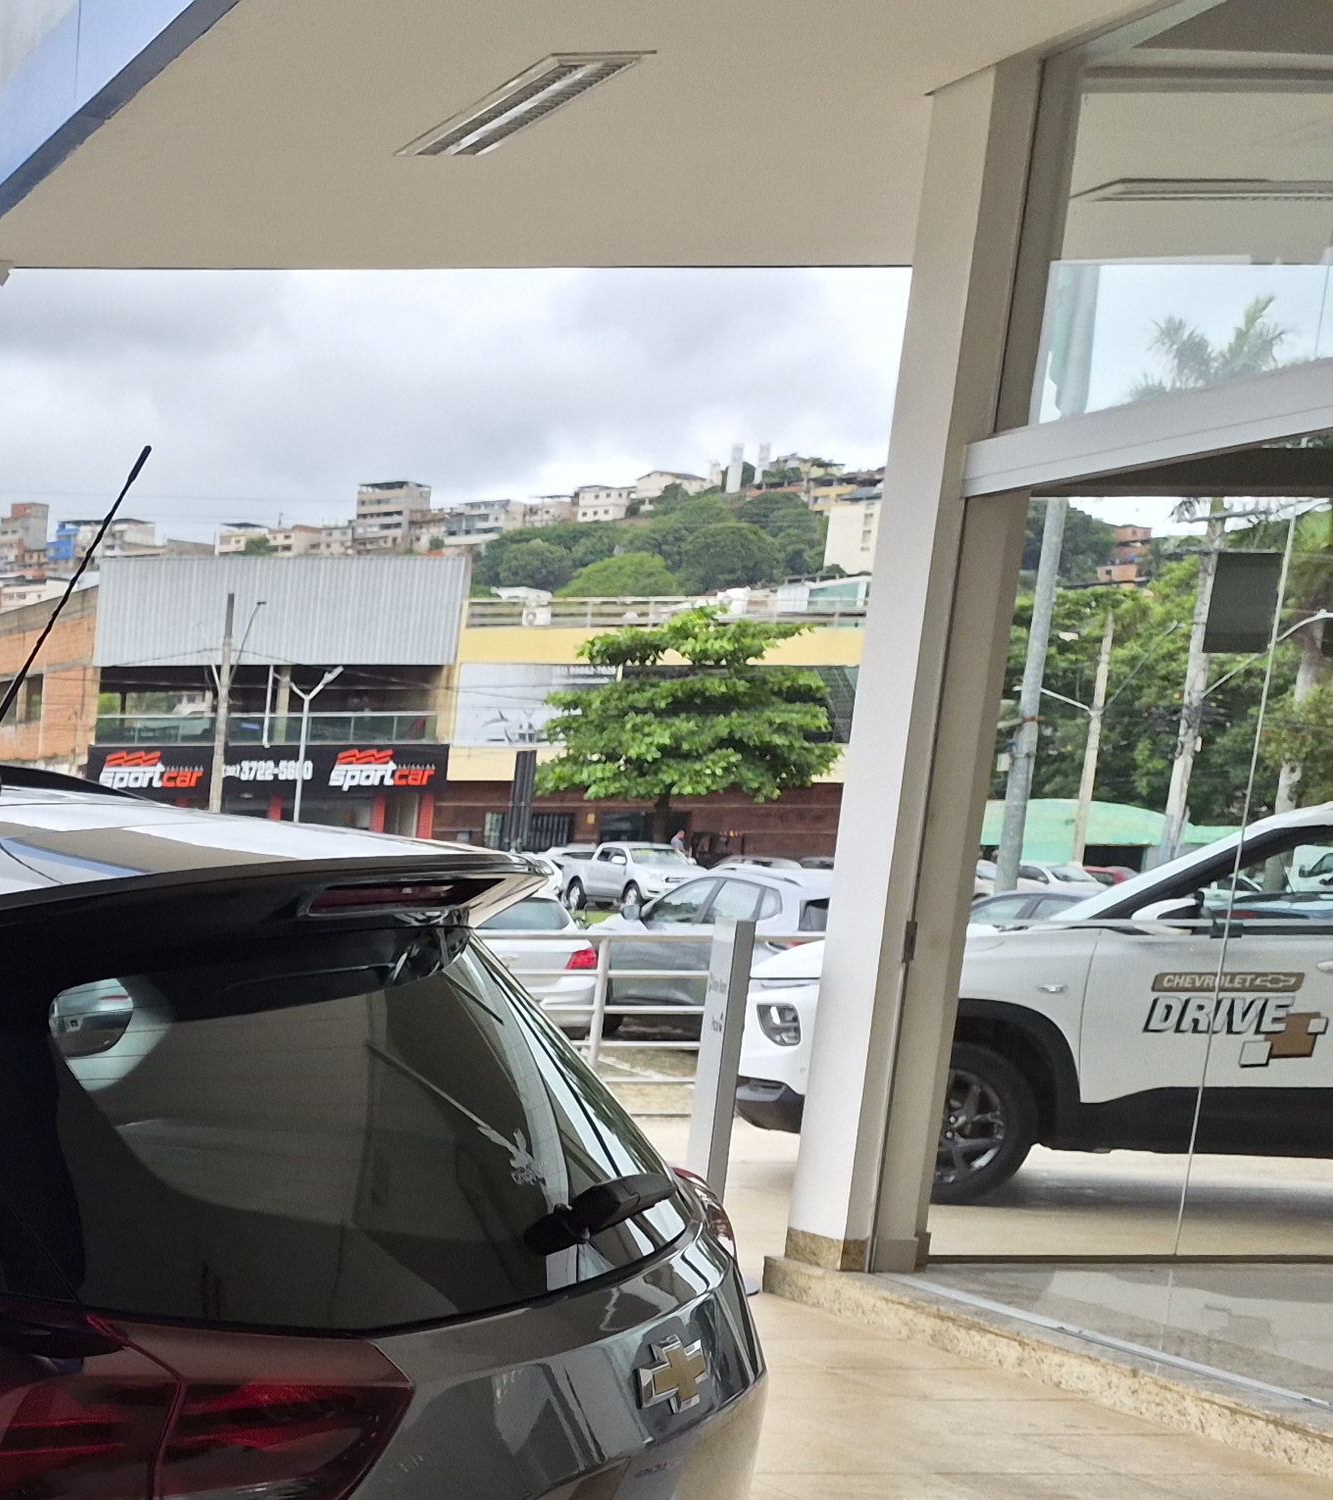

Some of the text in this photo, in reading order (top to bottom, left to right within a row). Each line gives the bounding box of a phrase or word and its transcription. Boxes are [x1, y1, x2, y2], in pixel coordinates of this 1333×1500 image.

[328, 760, 435, 792] sportcar
[1163, 974, 1256, 988] CHEVROLET
[1142, 996, 1296, 1035] DRIVE
